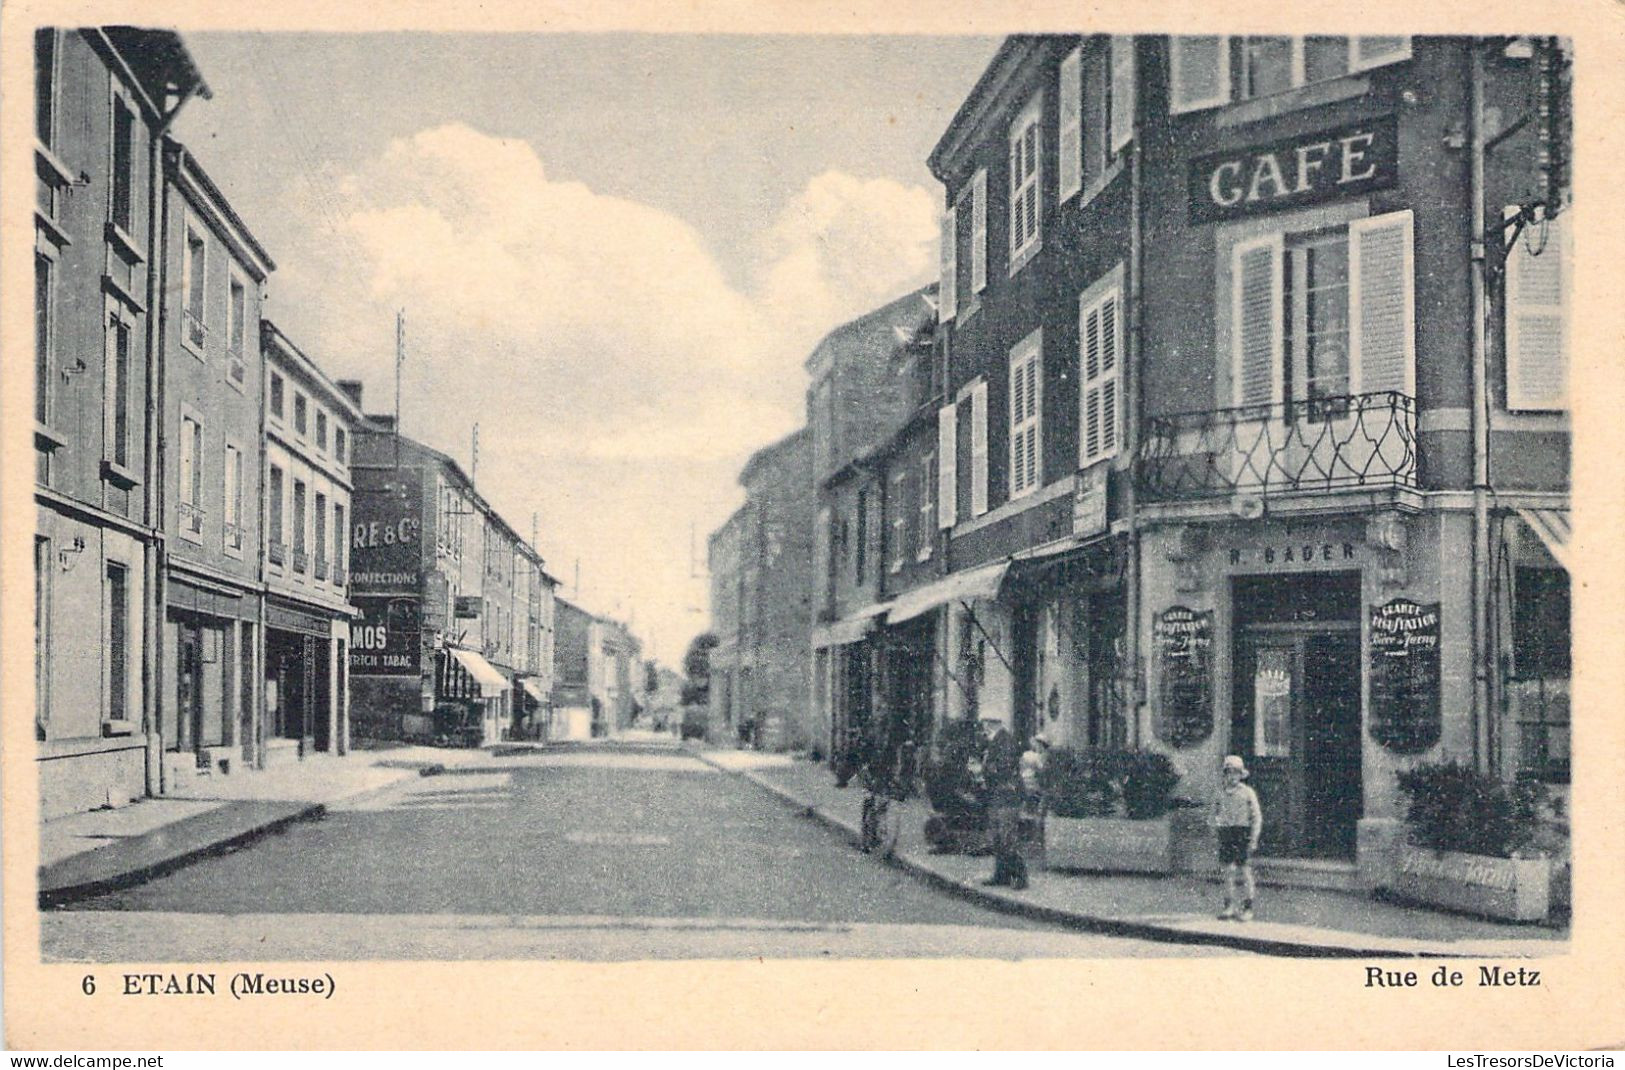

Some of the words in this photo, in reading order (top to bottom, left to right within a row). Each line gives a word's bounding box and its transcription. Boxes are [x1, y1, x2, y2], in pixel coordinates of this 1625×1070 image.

[349, 625, 387, 650] MOS
[383, 655, 412, 668] TABAC
[82, 974, 97, 996] 6
[123, 973, 216, 995] ETAIN
[230, 973, 336, 1000] (Meuse)
[1364, 966, 1418, 988] Rue
[1431, 966, 1464, 987] de
[1478, 966, 1542, 987] Metz
